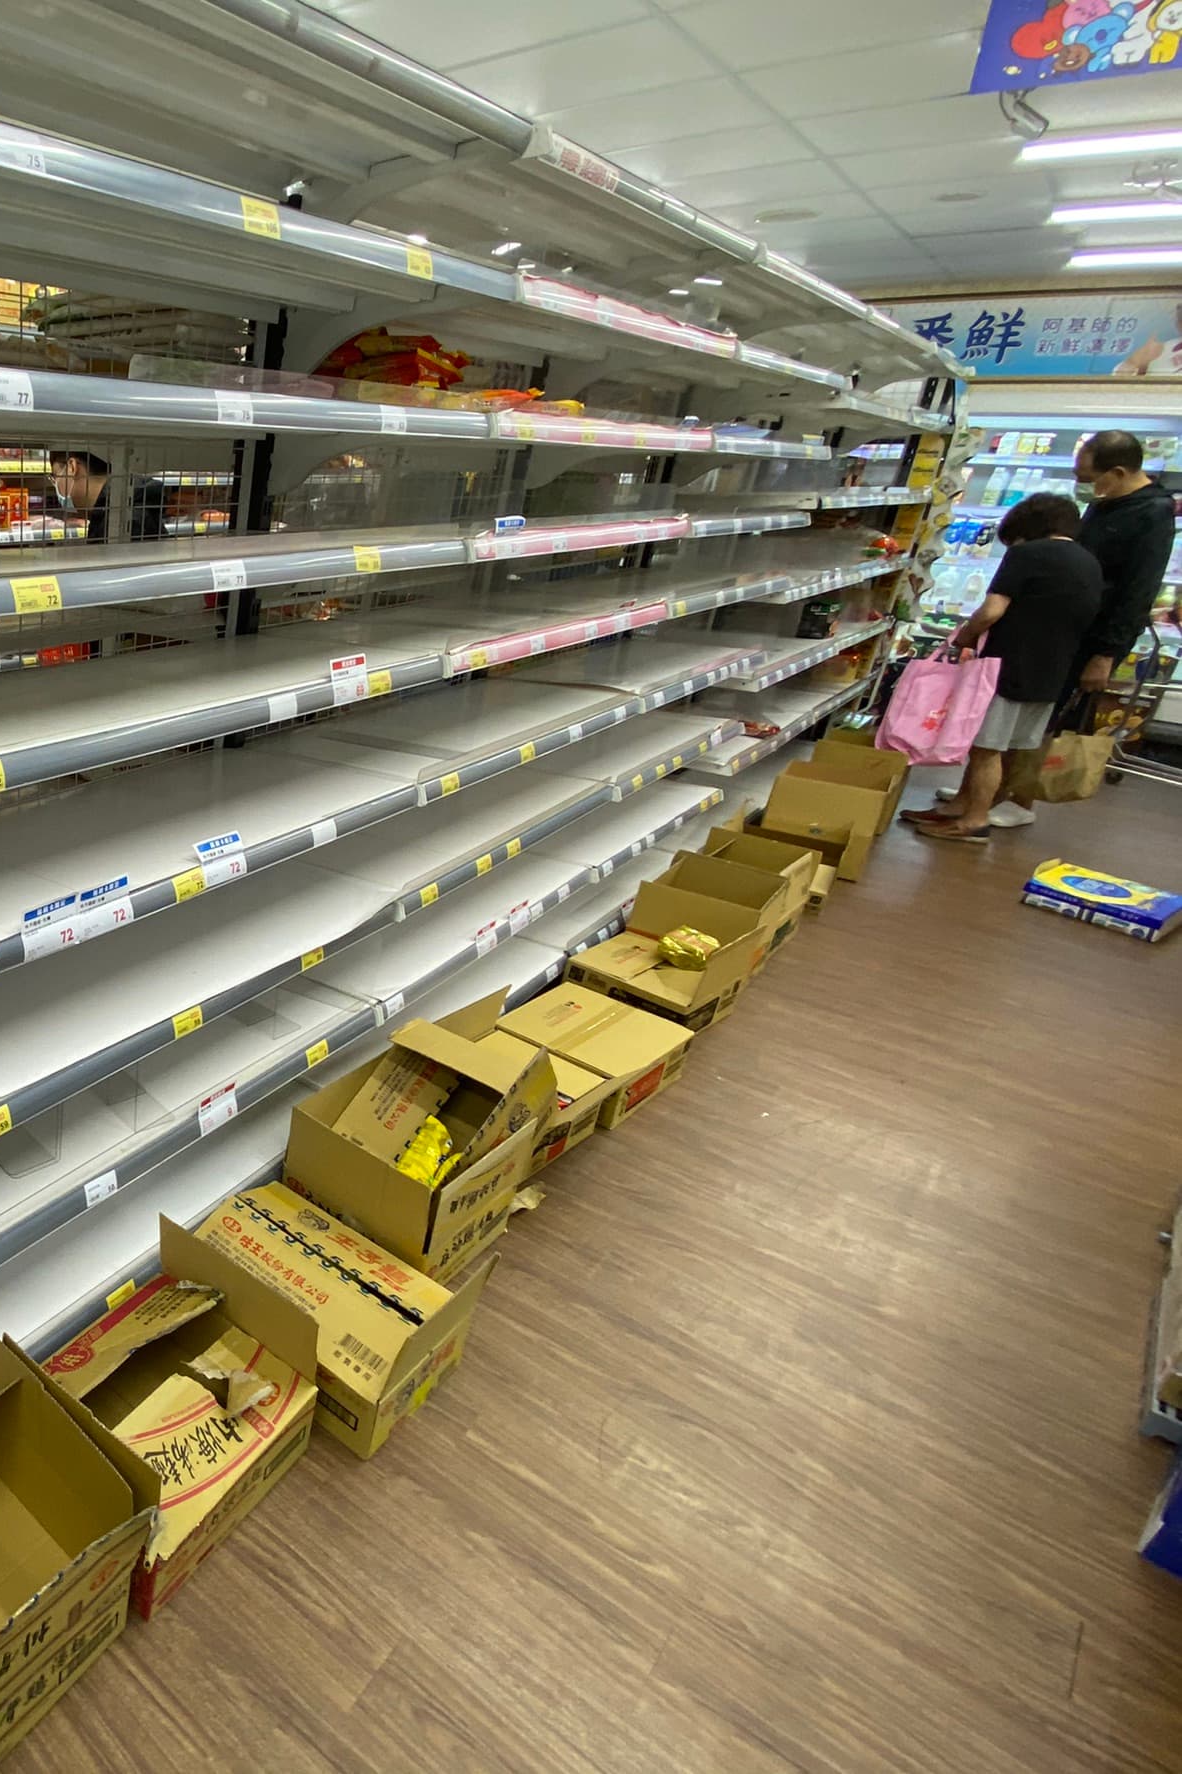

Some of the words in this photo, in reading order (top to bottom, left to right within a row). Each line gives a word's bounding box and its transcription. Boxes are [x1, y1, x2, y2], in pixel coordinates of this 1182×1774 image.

[1041, 316, 1139, 334] 阿基師的
[1036, 337, 1133, 354] 新鮮選擇
[17, 392, 29, 405] 77
[47, 595, 59, 606] 72
[230, 861, 241, 874] 72
[112, 908, 126, 923] 72
[60, 927, 74, 944] 72
[238, 1234, 330, 1305] 味王股份有限公司
